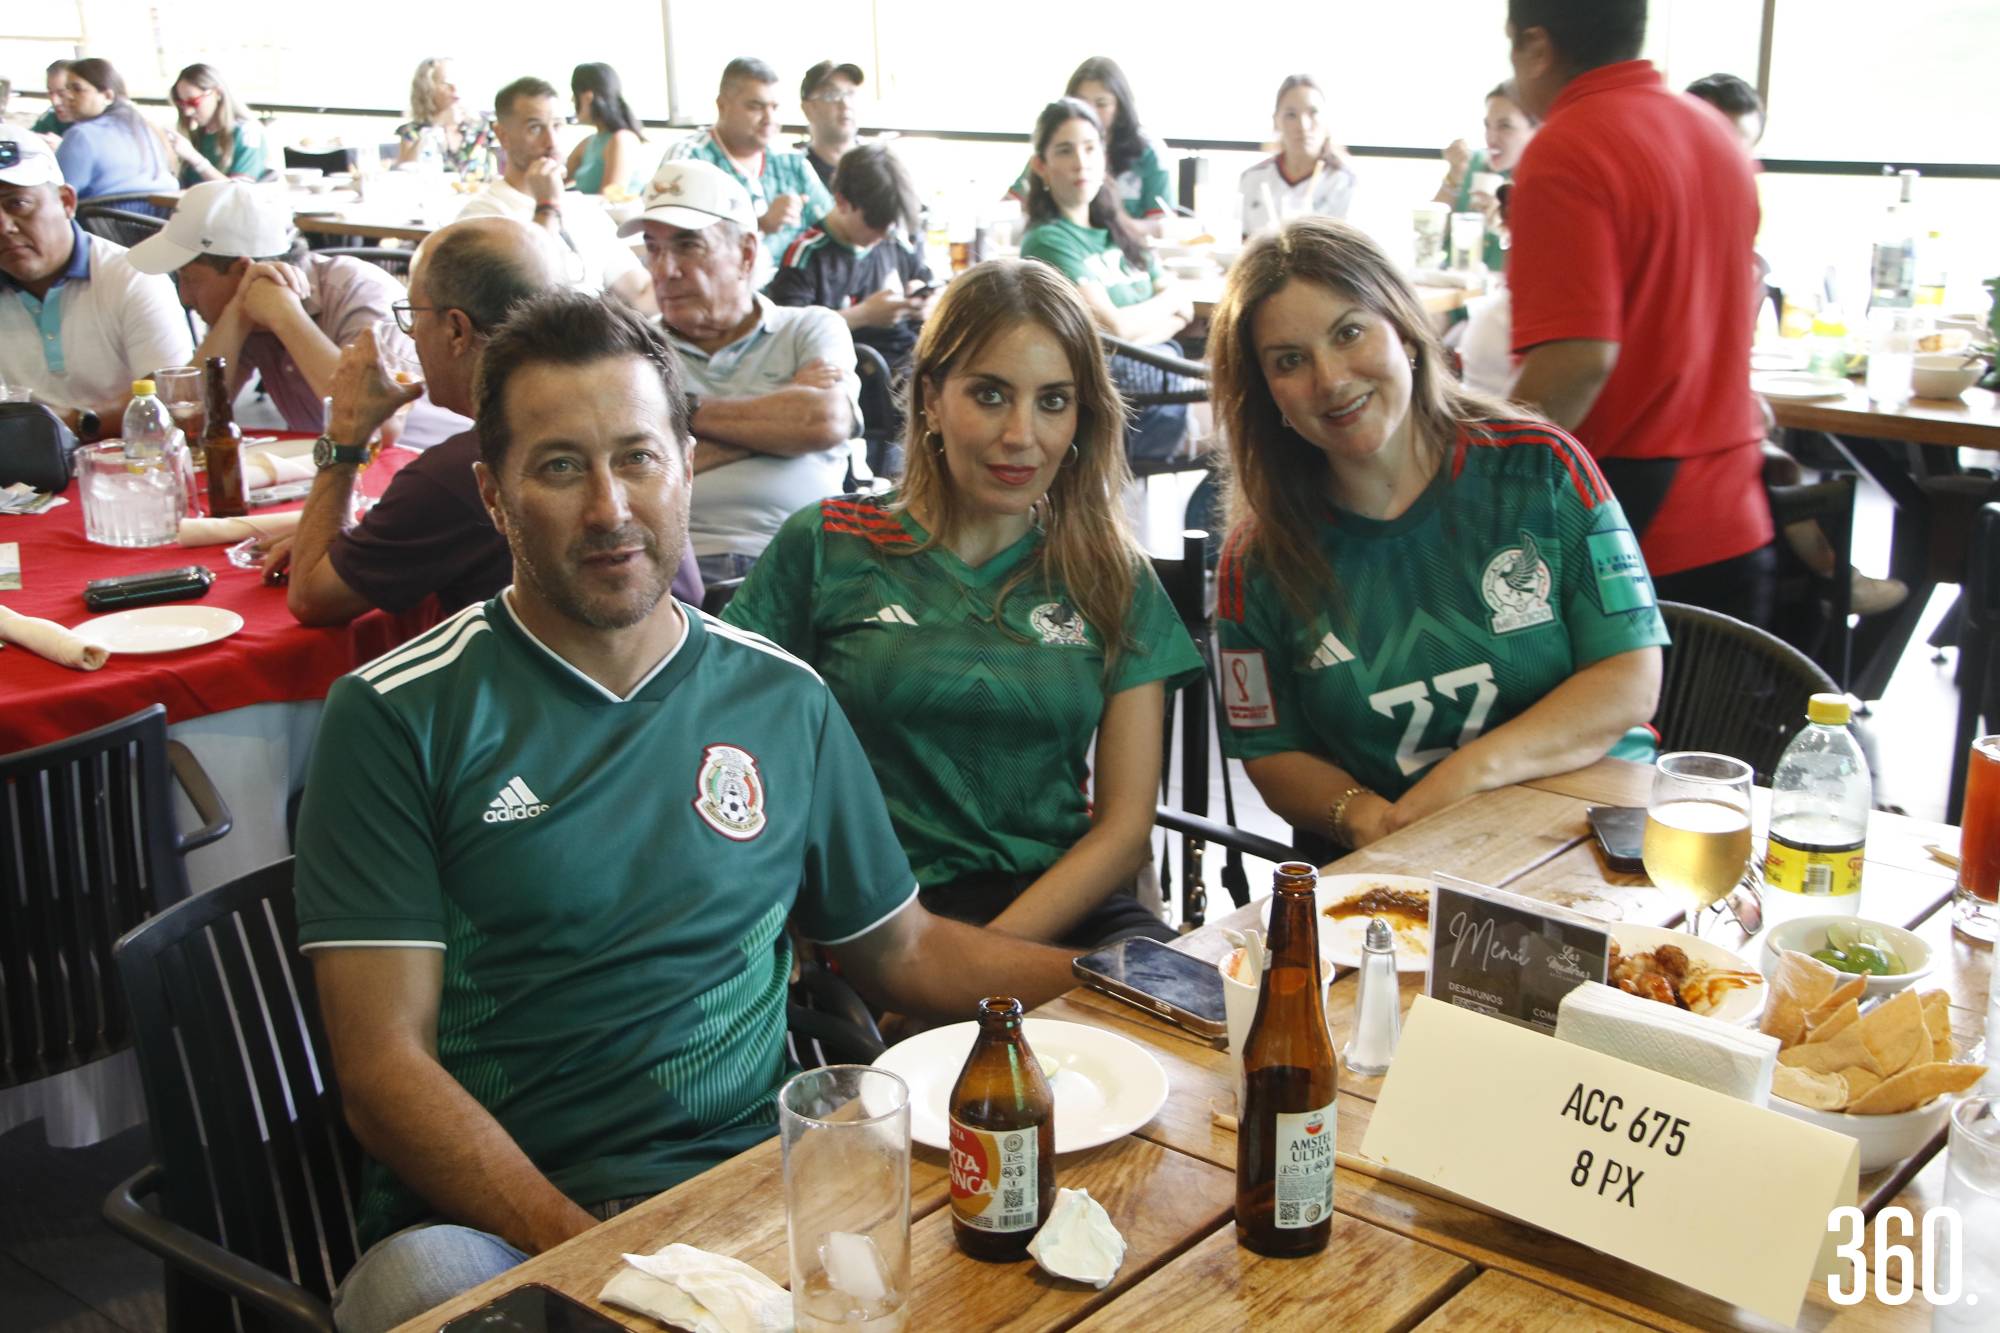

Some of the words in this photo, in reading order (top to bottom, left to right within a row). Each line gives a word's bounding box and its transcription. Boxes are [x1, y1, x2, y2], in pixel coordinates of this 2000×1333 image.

[1448, 981, 1503, 1006] DESAYUNOS
[1532, 1007, 1557, 1021] COM
[1560, 1082, 1624, 1133] ACC
[1628, 1106, 1691, 1157] 675
[1290, 1131, 1332, 1152] AMSTEL
[1292, 1143, 1331, 1162] ULTRA
[1570, 1150, 1594, 1187] 8
[1597, 1159, 1645, 1208] PX
